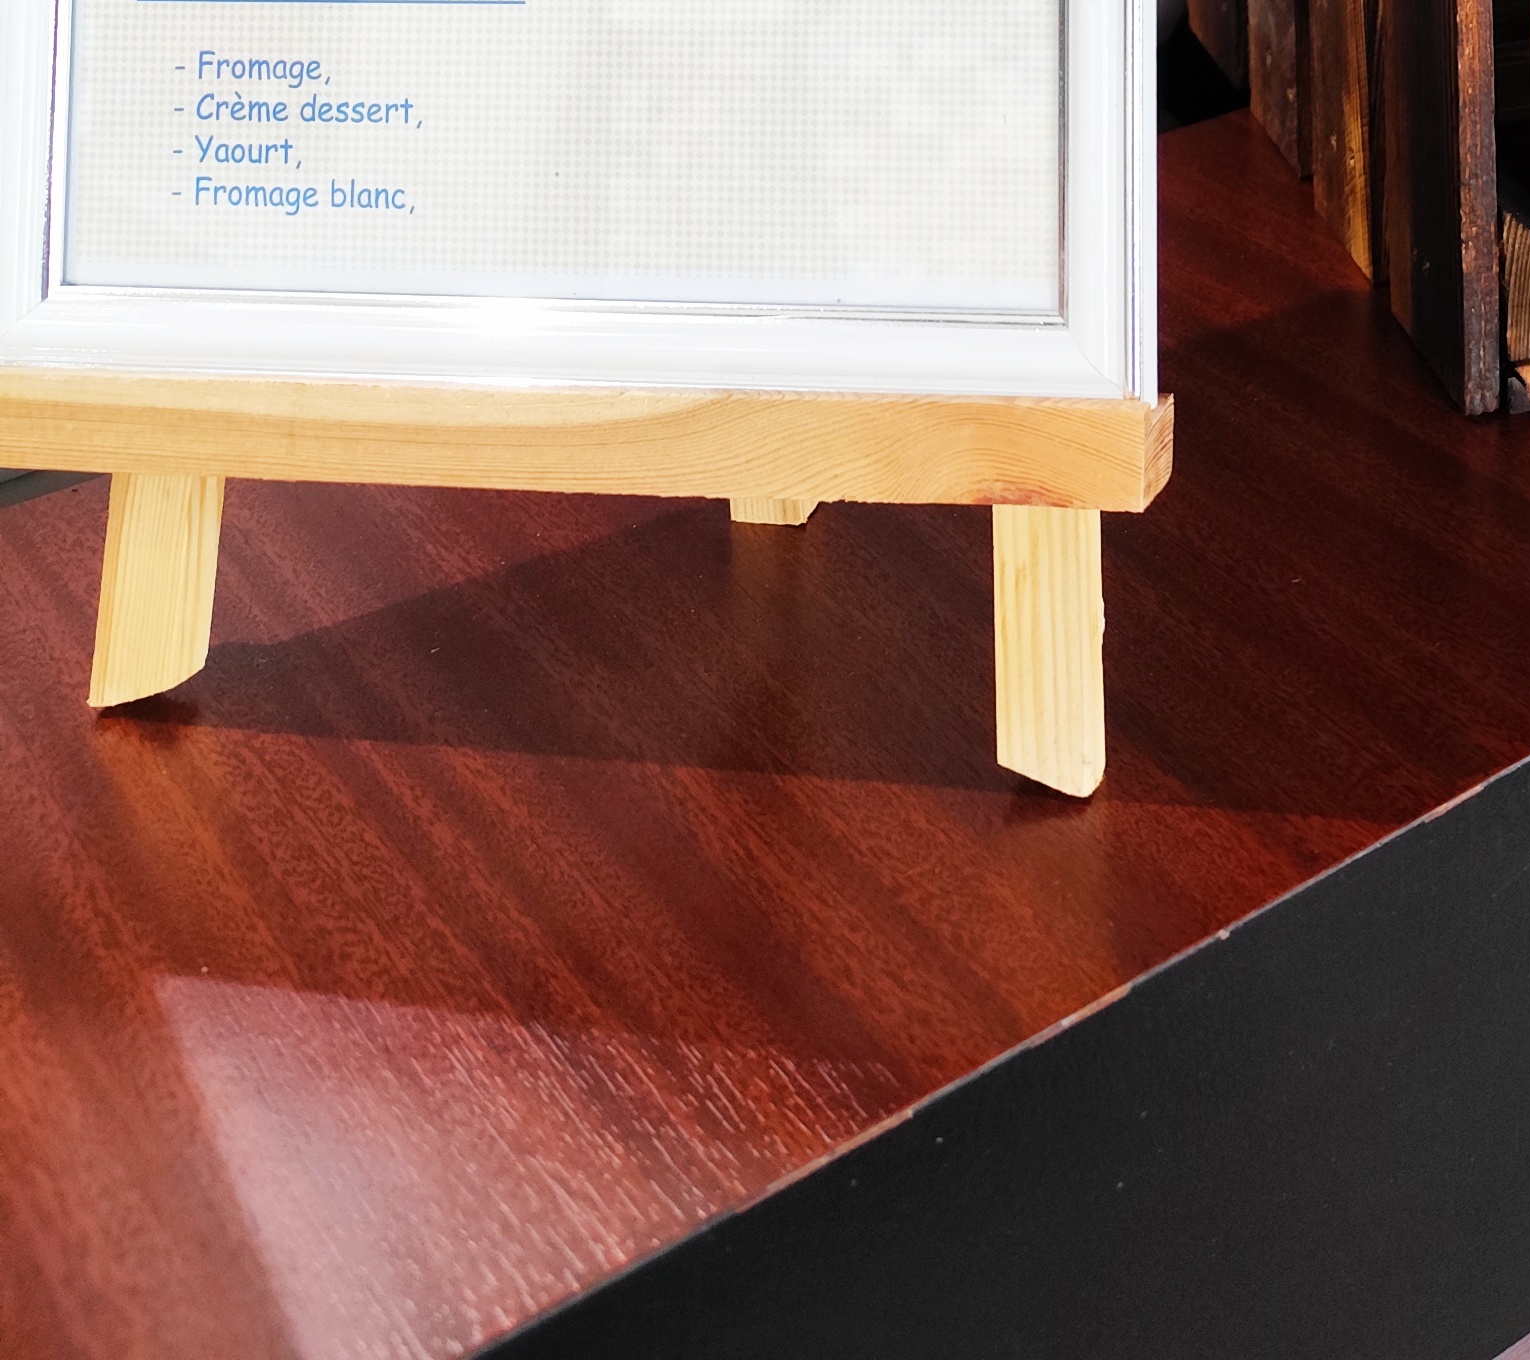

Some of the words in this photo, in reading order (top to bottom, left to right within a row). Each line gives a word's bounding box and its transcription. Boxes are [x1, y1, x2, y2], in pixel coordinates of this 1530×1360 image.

[198, 50, 331, 89] Fromage,
[196, 90, 289, 123] Crème
[299, 93, 423, 129] dessert,
[194, 134, 302, 170] Yaourt,
[195, 176, 319, 216] Fromage
[330, 178, 415, 215] blanc,
